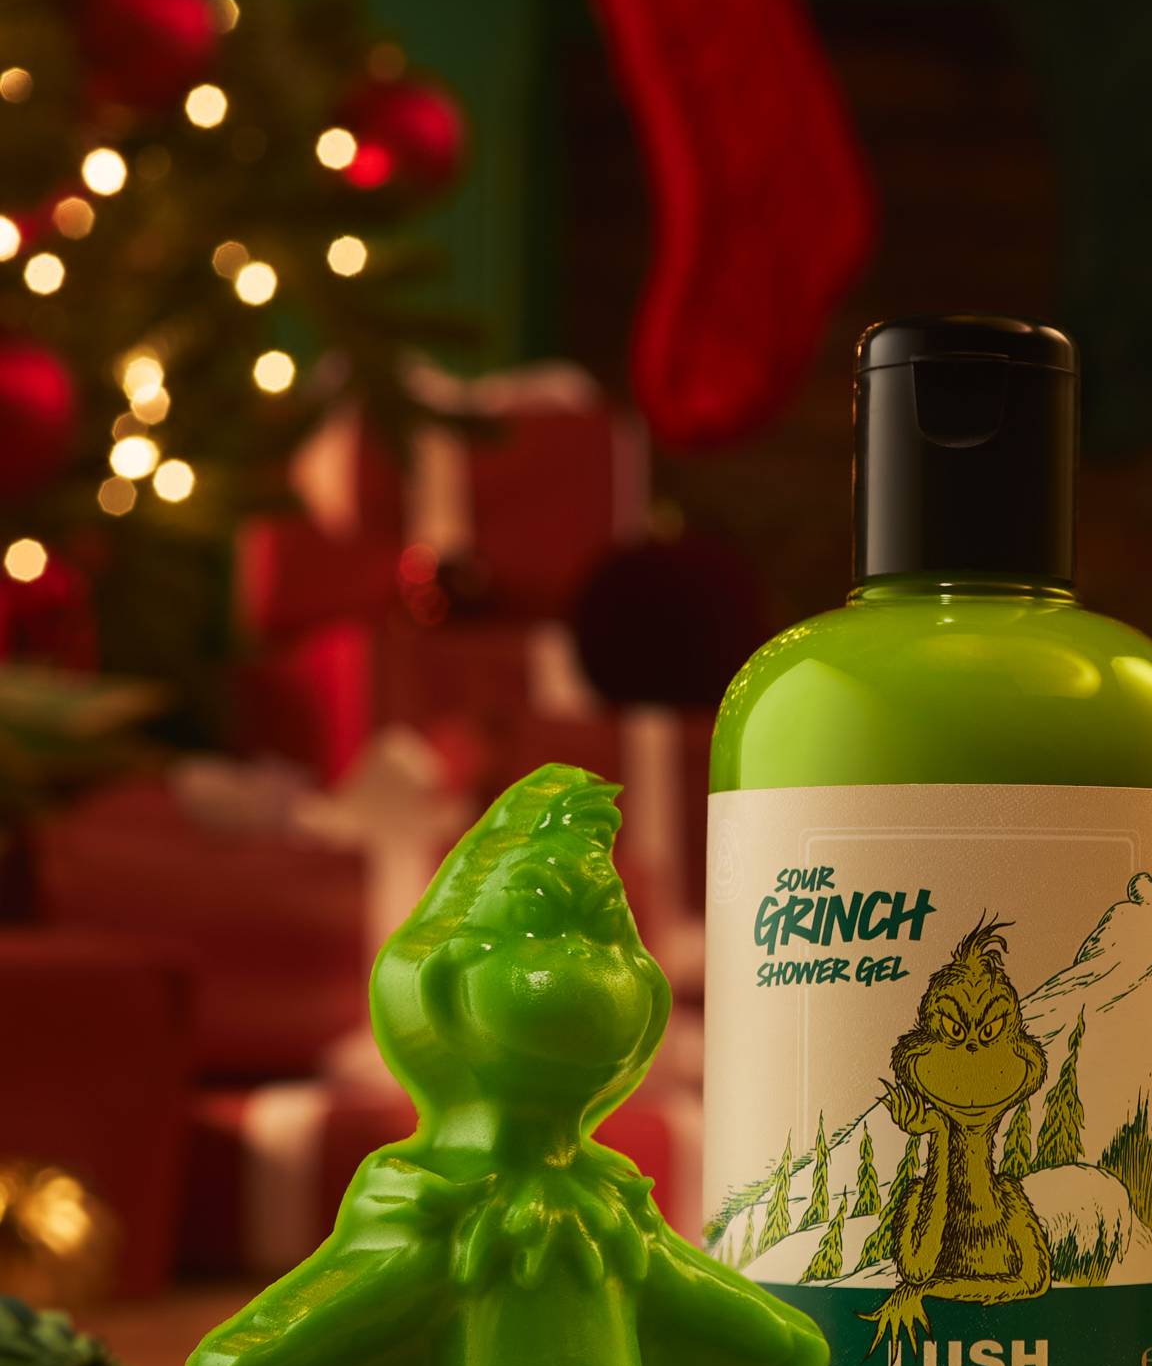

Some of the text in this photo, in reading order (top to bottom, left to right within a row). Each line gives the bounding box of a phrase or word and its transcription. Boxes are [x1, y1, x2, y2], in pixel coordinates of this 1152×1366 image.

[773, 865, 836, 893] SOUR
[753, 888, 938, 955] GRINCH
[755, 955, 911, 988] SHOWER GEL
